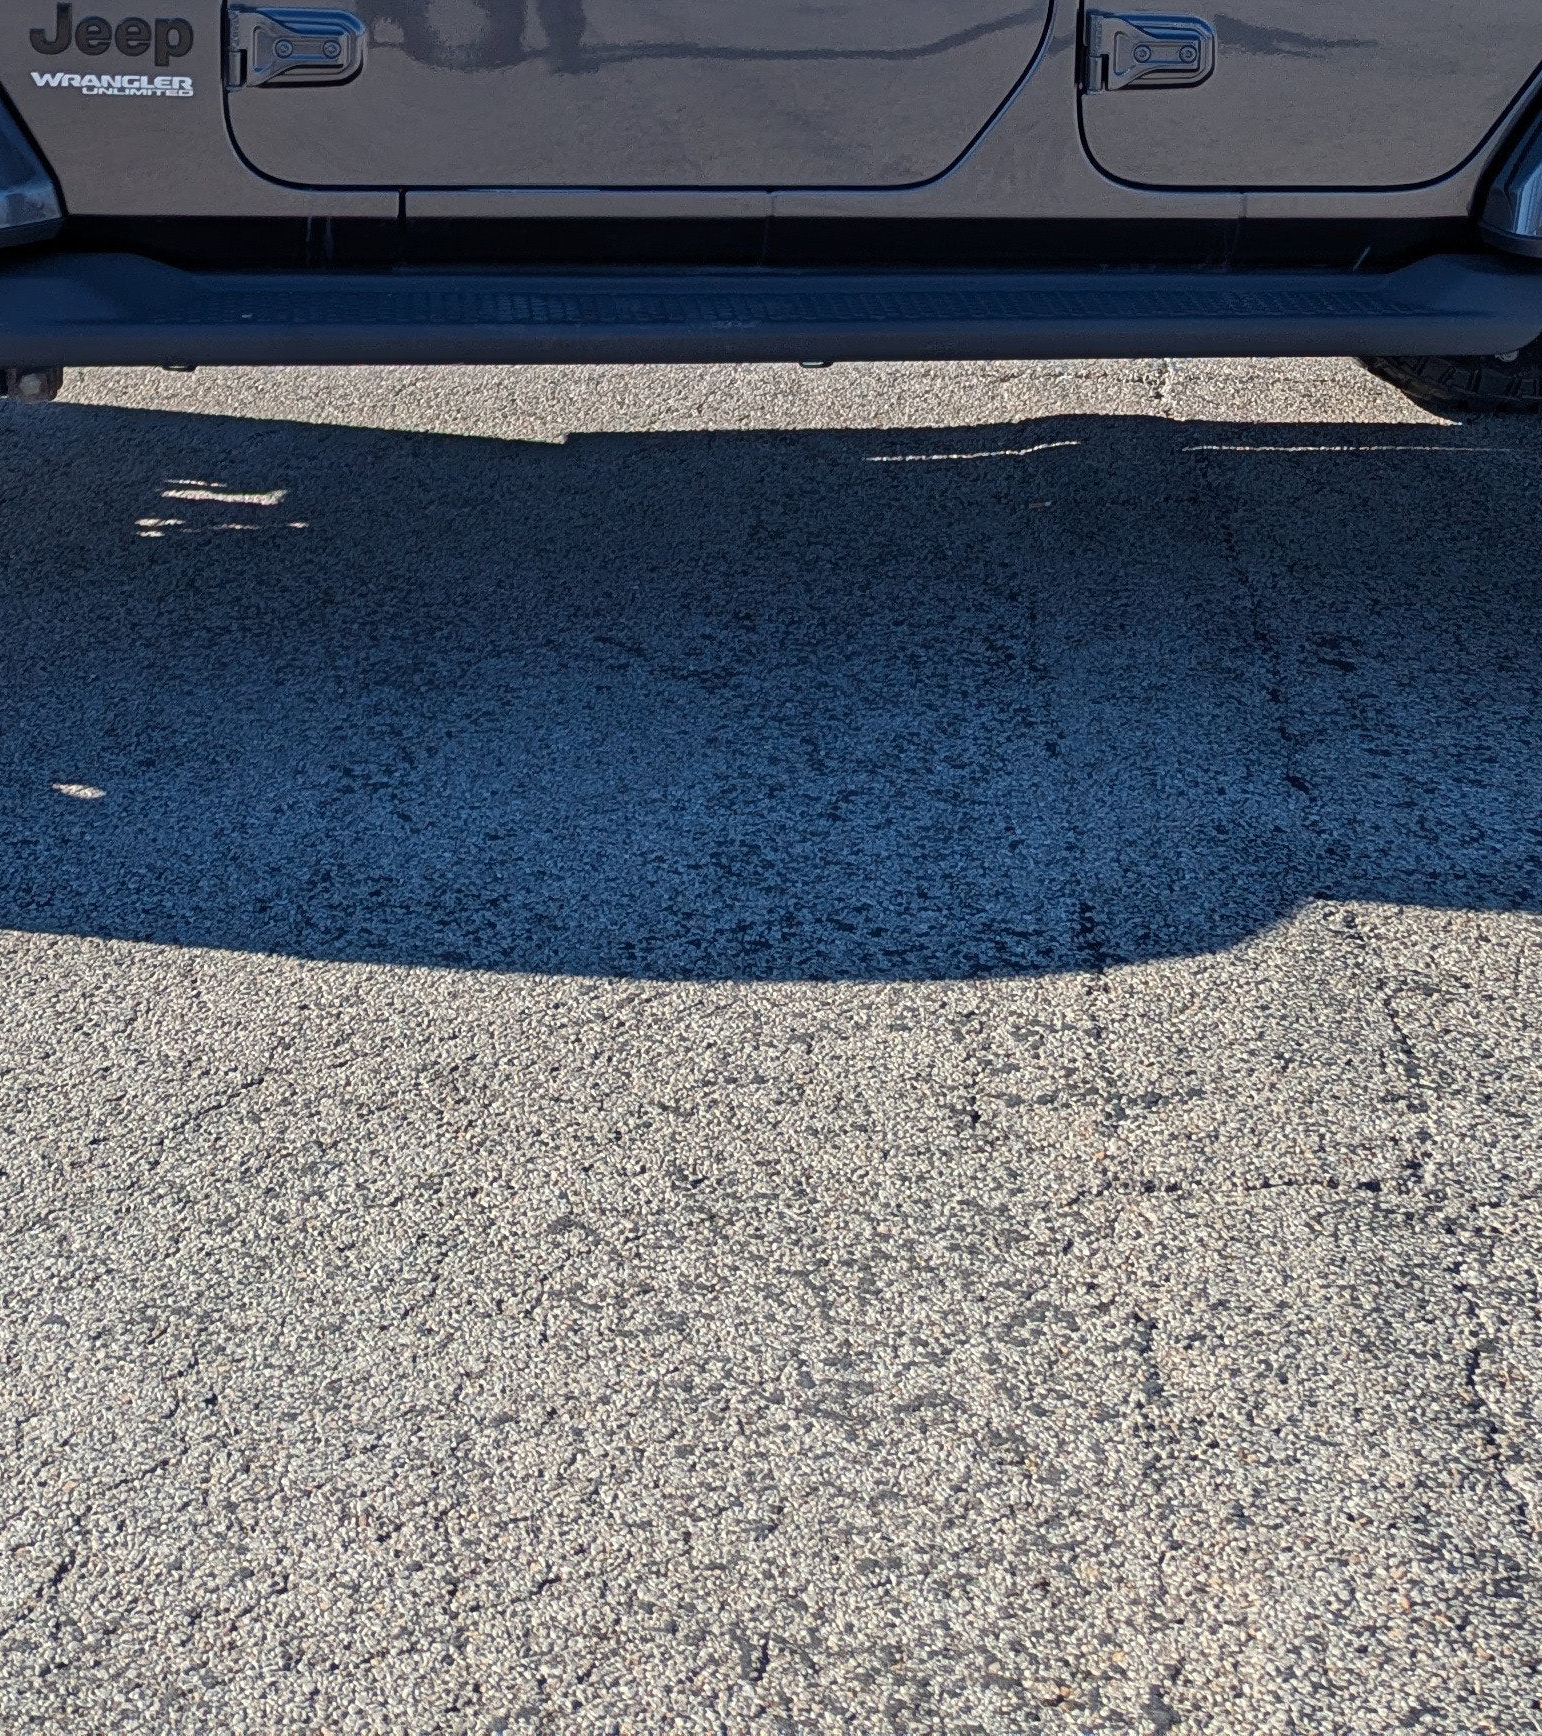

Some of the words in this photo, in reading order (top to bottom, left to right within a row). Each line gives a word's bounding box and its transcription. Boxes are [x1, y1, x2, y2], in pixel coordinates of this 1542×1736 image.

[29, 2, 194, 67] Jeep
[30, 72, 193, 89] WRANGLER
[81, 87, 194, 97] UNLIMITED
